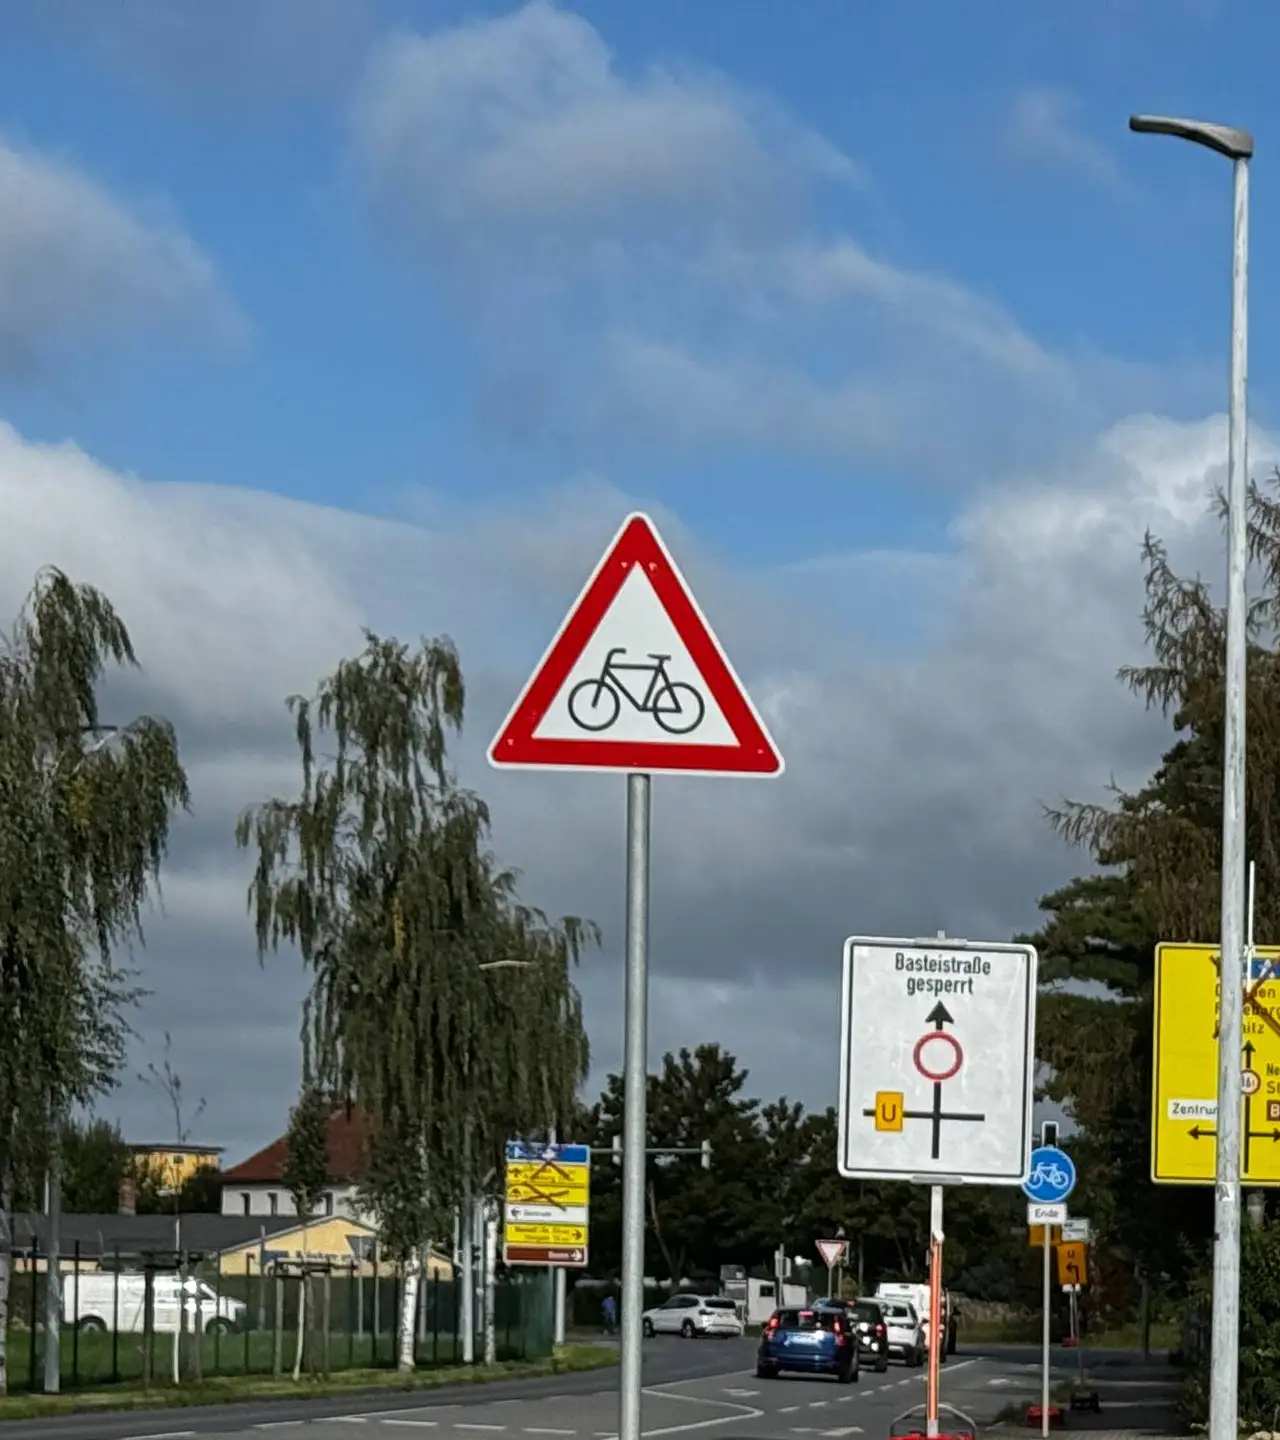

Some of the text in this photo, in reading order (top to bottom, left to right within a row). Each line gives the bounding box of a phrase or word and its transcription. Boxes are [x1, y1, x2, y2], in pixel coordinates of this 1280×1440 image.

[895, 952, 991, 975] Basteistraße
[907, 976, 974, 997] gesperrt
[881, 1104, 897, 1123] U
[1034, 1208, 1059, 1218] Ende
